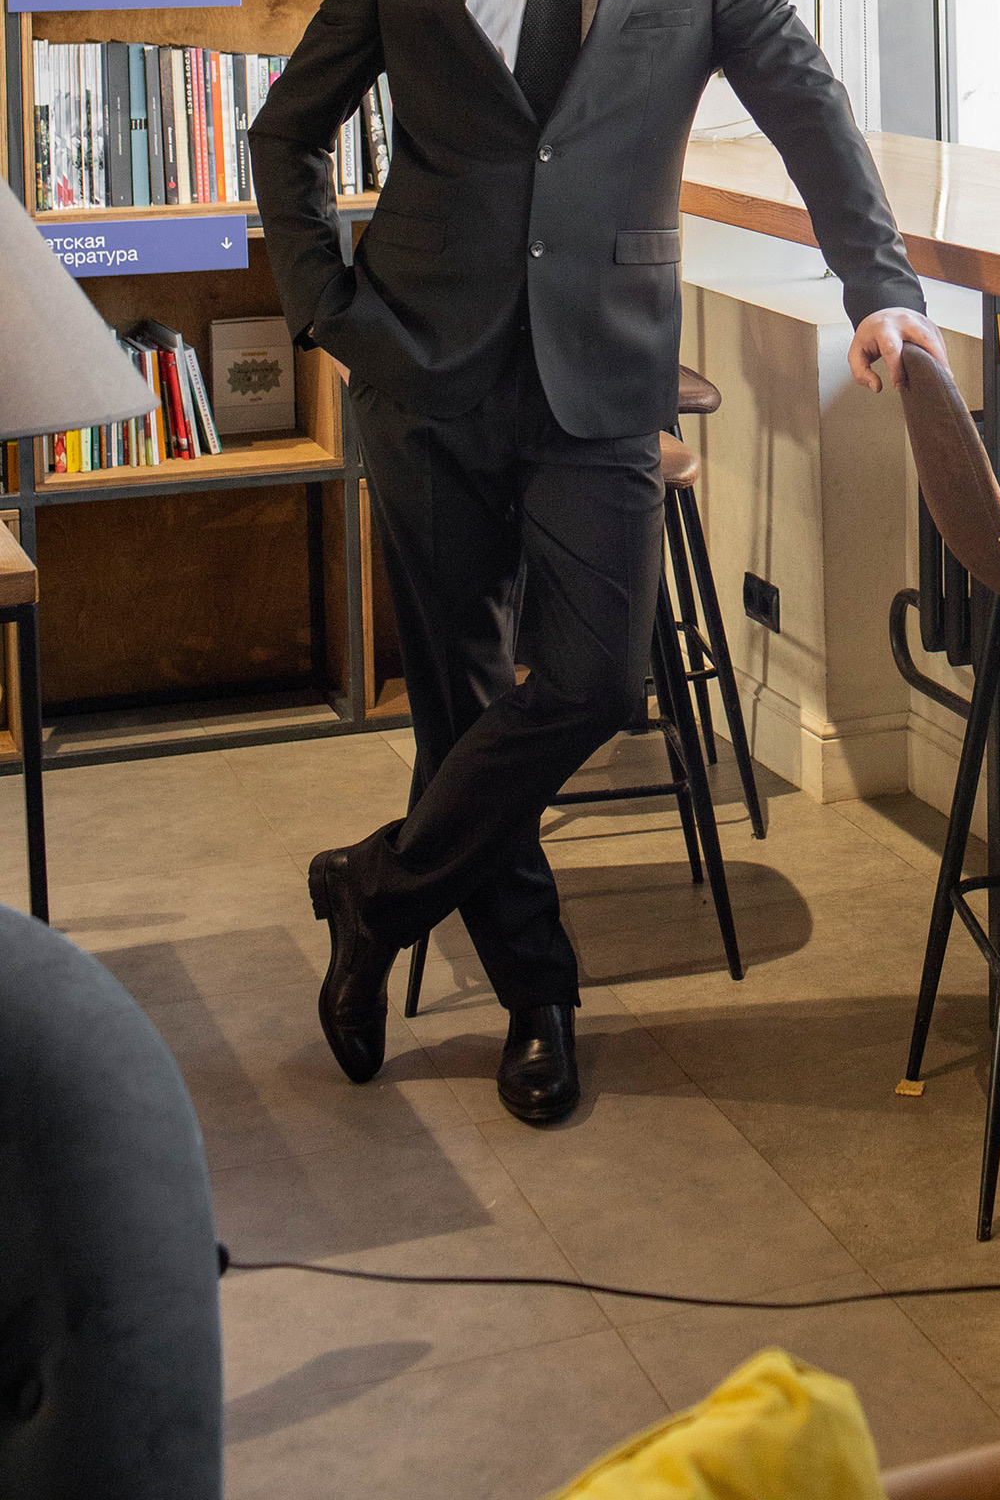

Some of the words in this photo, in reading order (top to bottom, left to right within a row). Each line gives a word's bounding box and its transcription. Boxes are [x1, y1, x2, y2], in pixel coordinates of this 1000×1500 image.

[344, 124, 352, 178] ФОТОРЕАЛИЗМ
[45, 236, 105, 250] етская
[56, 249, 138, 267] тература
